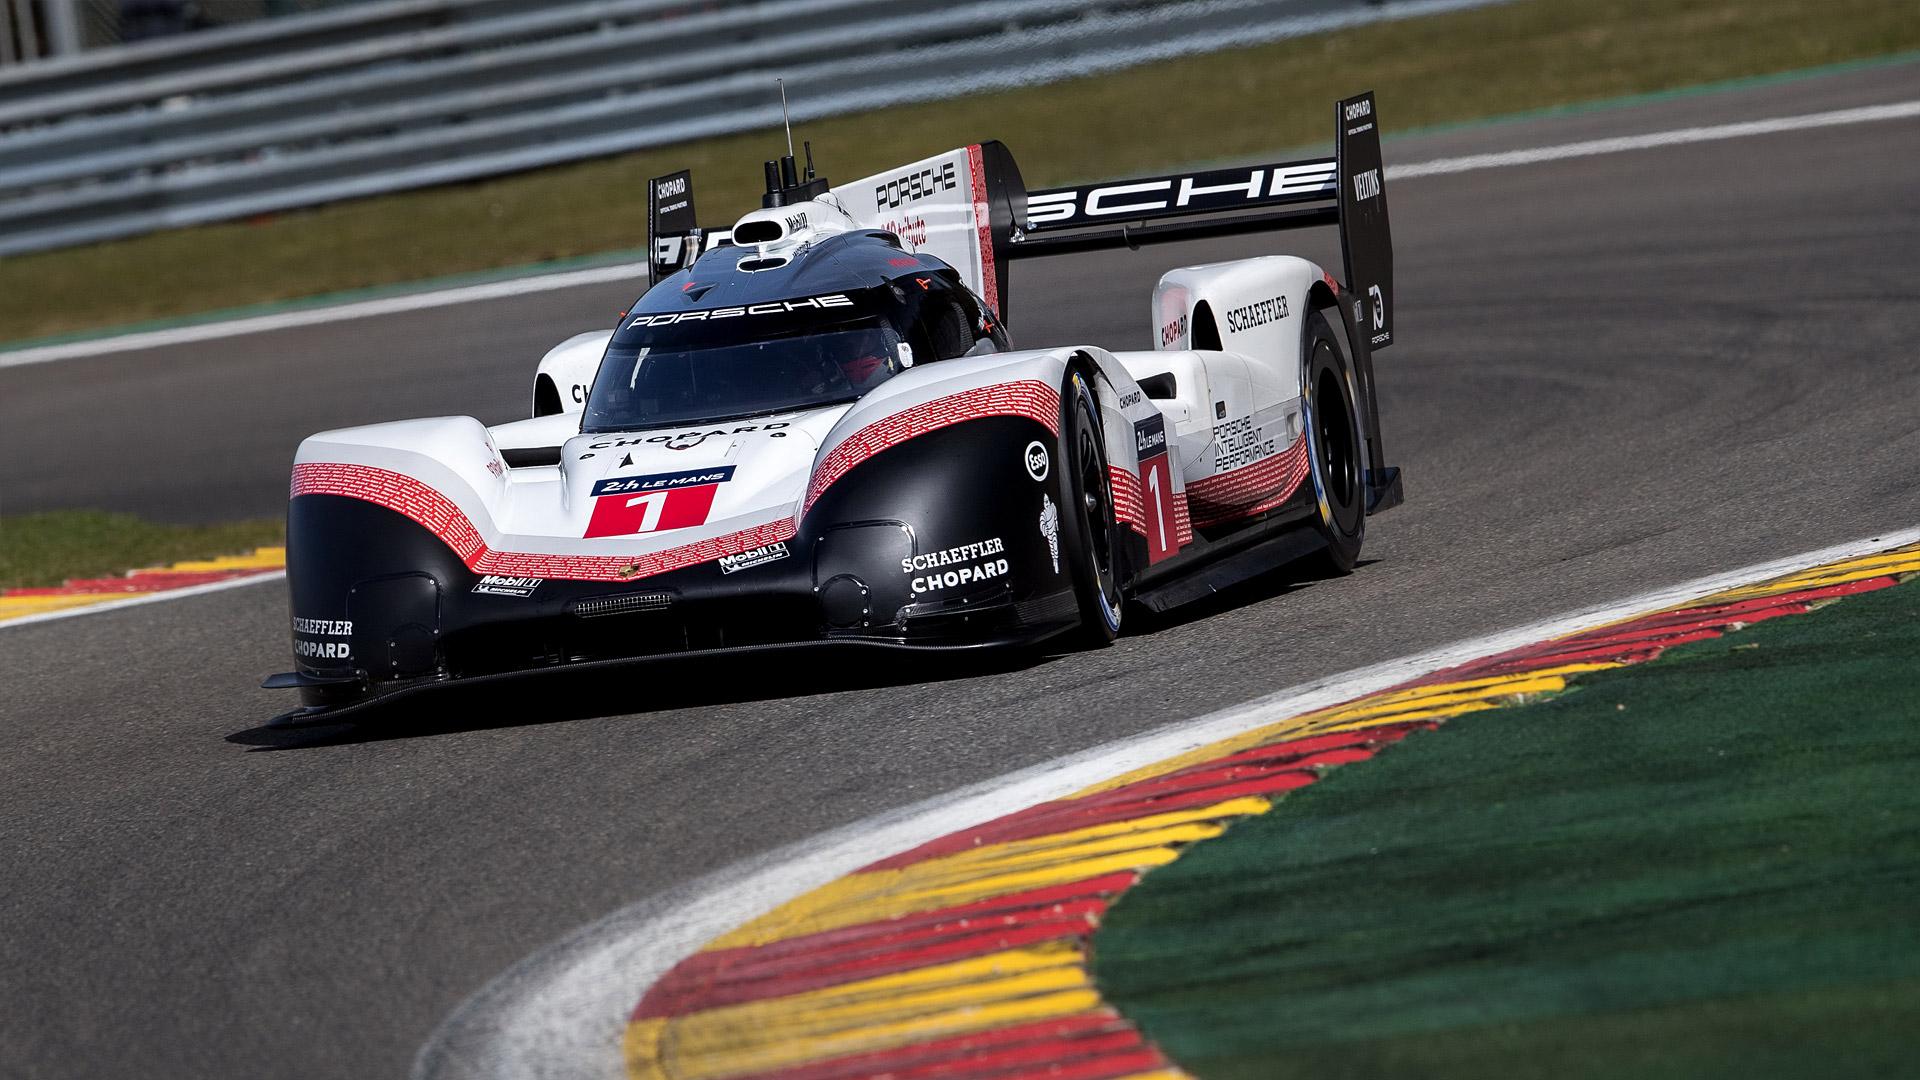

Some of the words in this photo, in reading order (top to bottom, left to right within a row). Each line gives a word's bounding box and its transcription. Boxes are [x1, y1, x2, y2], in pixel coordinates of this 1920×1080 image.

[1345, 99, 1371, 121] CHOPARD
[657, 177, 686, 200] CHOPARD
[875, 162, 956, 213] PORSCHE
[1353, 168, 1380, 202] VELTINS
[627, 294, 854, 331] PORSCHE
[1226, 295, 1290, 334] SCHAEFFLER
[1161, 314, 1188, 348] CHOPARD
[1119, 390, 1141, 410] CHOPARD
[588, 422, 791, 450] CHOPARD
[1213, 415, 1252, 439] PORSCHE
[1214, 427, 1262, 457] INTELLIGENT
[1215, 439, 1275, 473] PERFORMANCE
[642, 479, 667, 489] LE
[668, 472, 725, 486] MANS
[625, 491, 669, 533] 1
[1148, 465, 1167, 552] 1
[718, 546, 768, 567] Mobil
[741, 552, 783, 567] MICHELIN
[901, 537, 1004, 574] SCHAEFFLER
[480, 575, 527, 587] Mobil
[911, 558, 1009, 593] CHOPARD
[293, 616, 353, 636] SCHAEFFLER
[295, 639, 350, 659] CHOPARD
